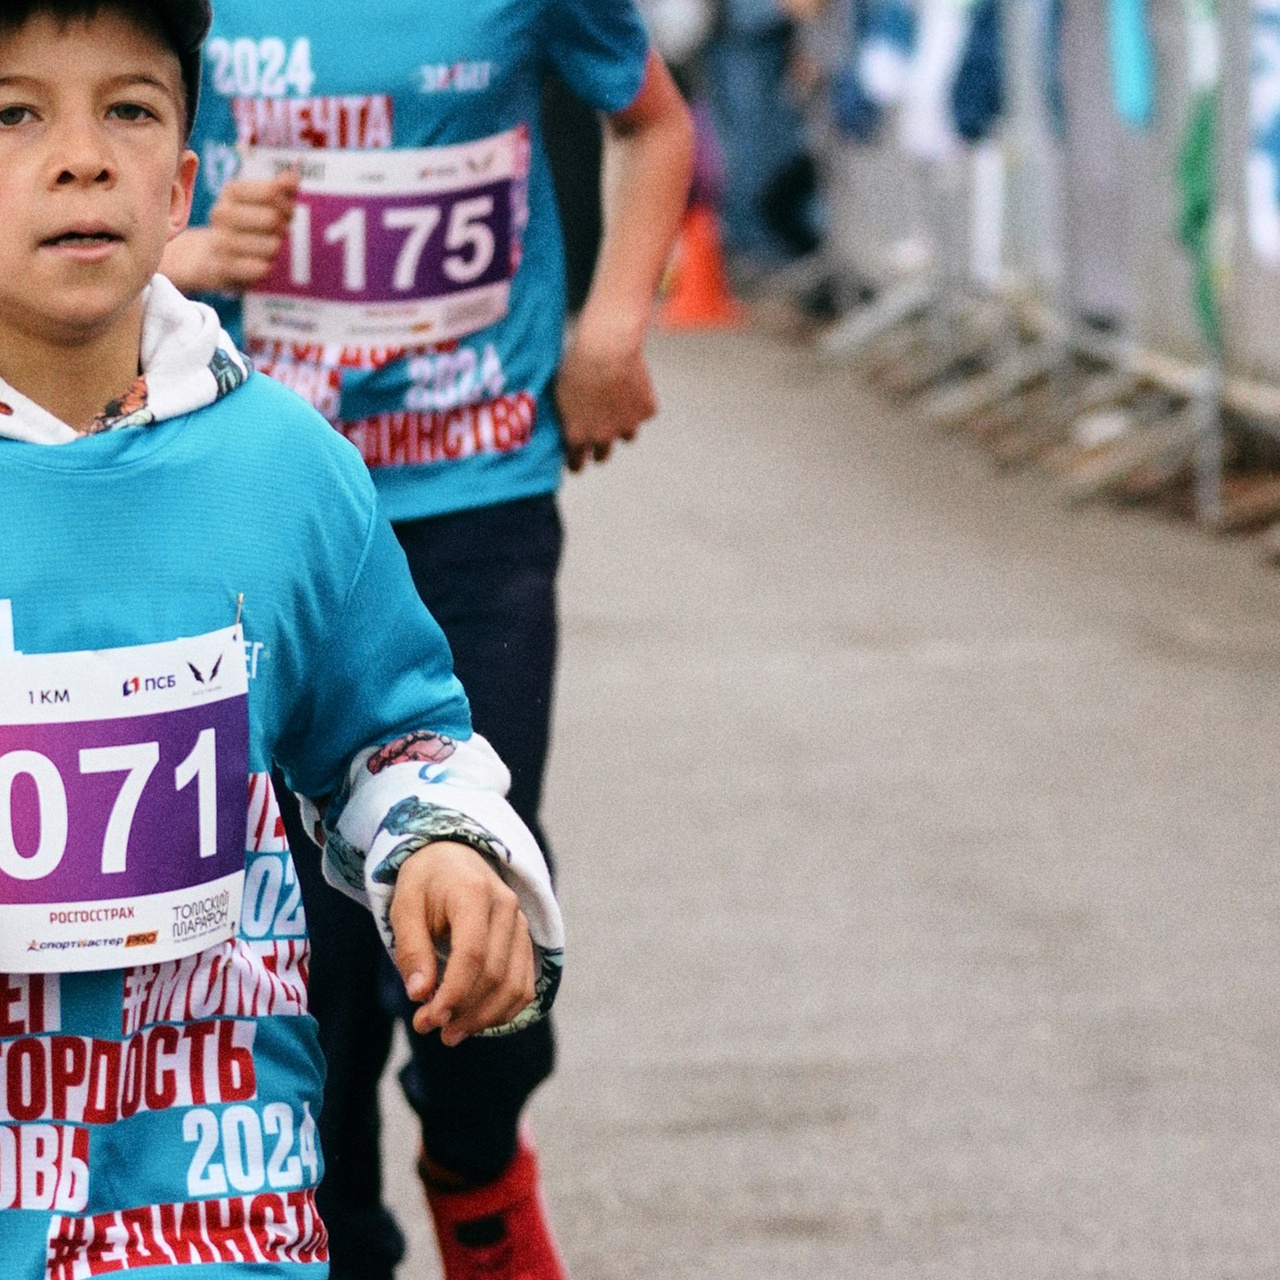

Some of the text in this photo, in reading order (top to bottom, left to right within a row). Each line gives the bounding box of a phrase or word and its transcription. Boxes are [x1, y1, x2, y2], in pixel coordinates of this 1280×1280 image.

[206, 35, 316, 97] 2024
[289, 195, 496, 292] 1175
[28, 690, 35, 705] 1
[144, 674, 177, 692] ПСБ
[49, 907, 135, 924] РОСГОССТРАХ
[182, 1102, 317, 1197] 2024
